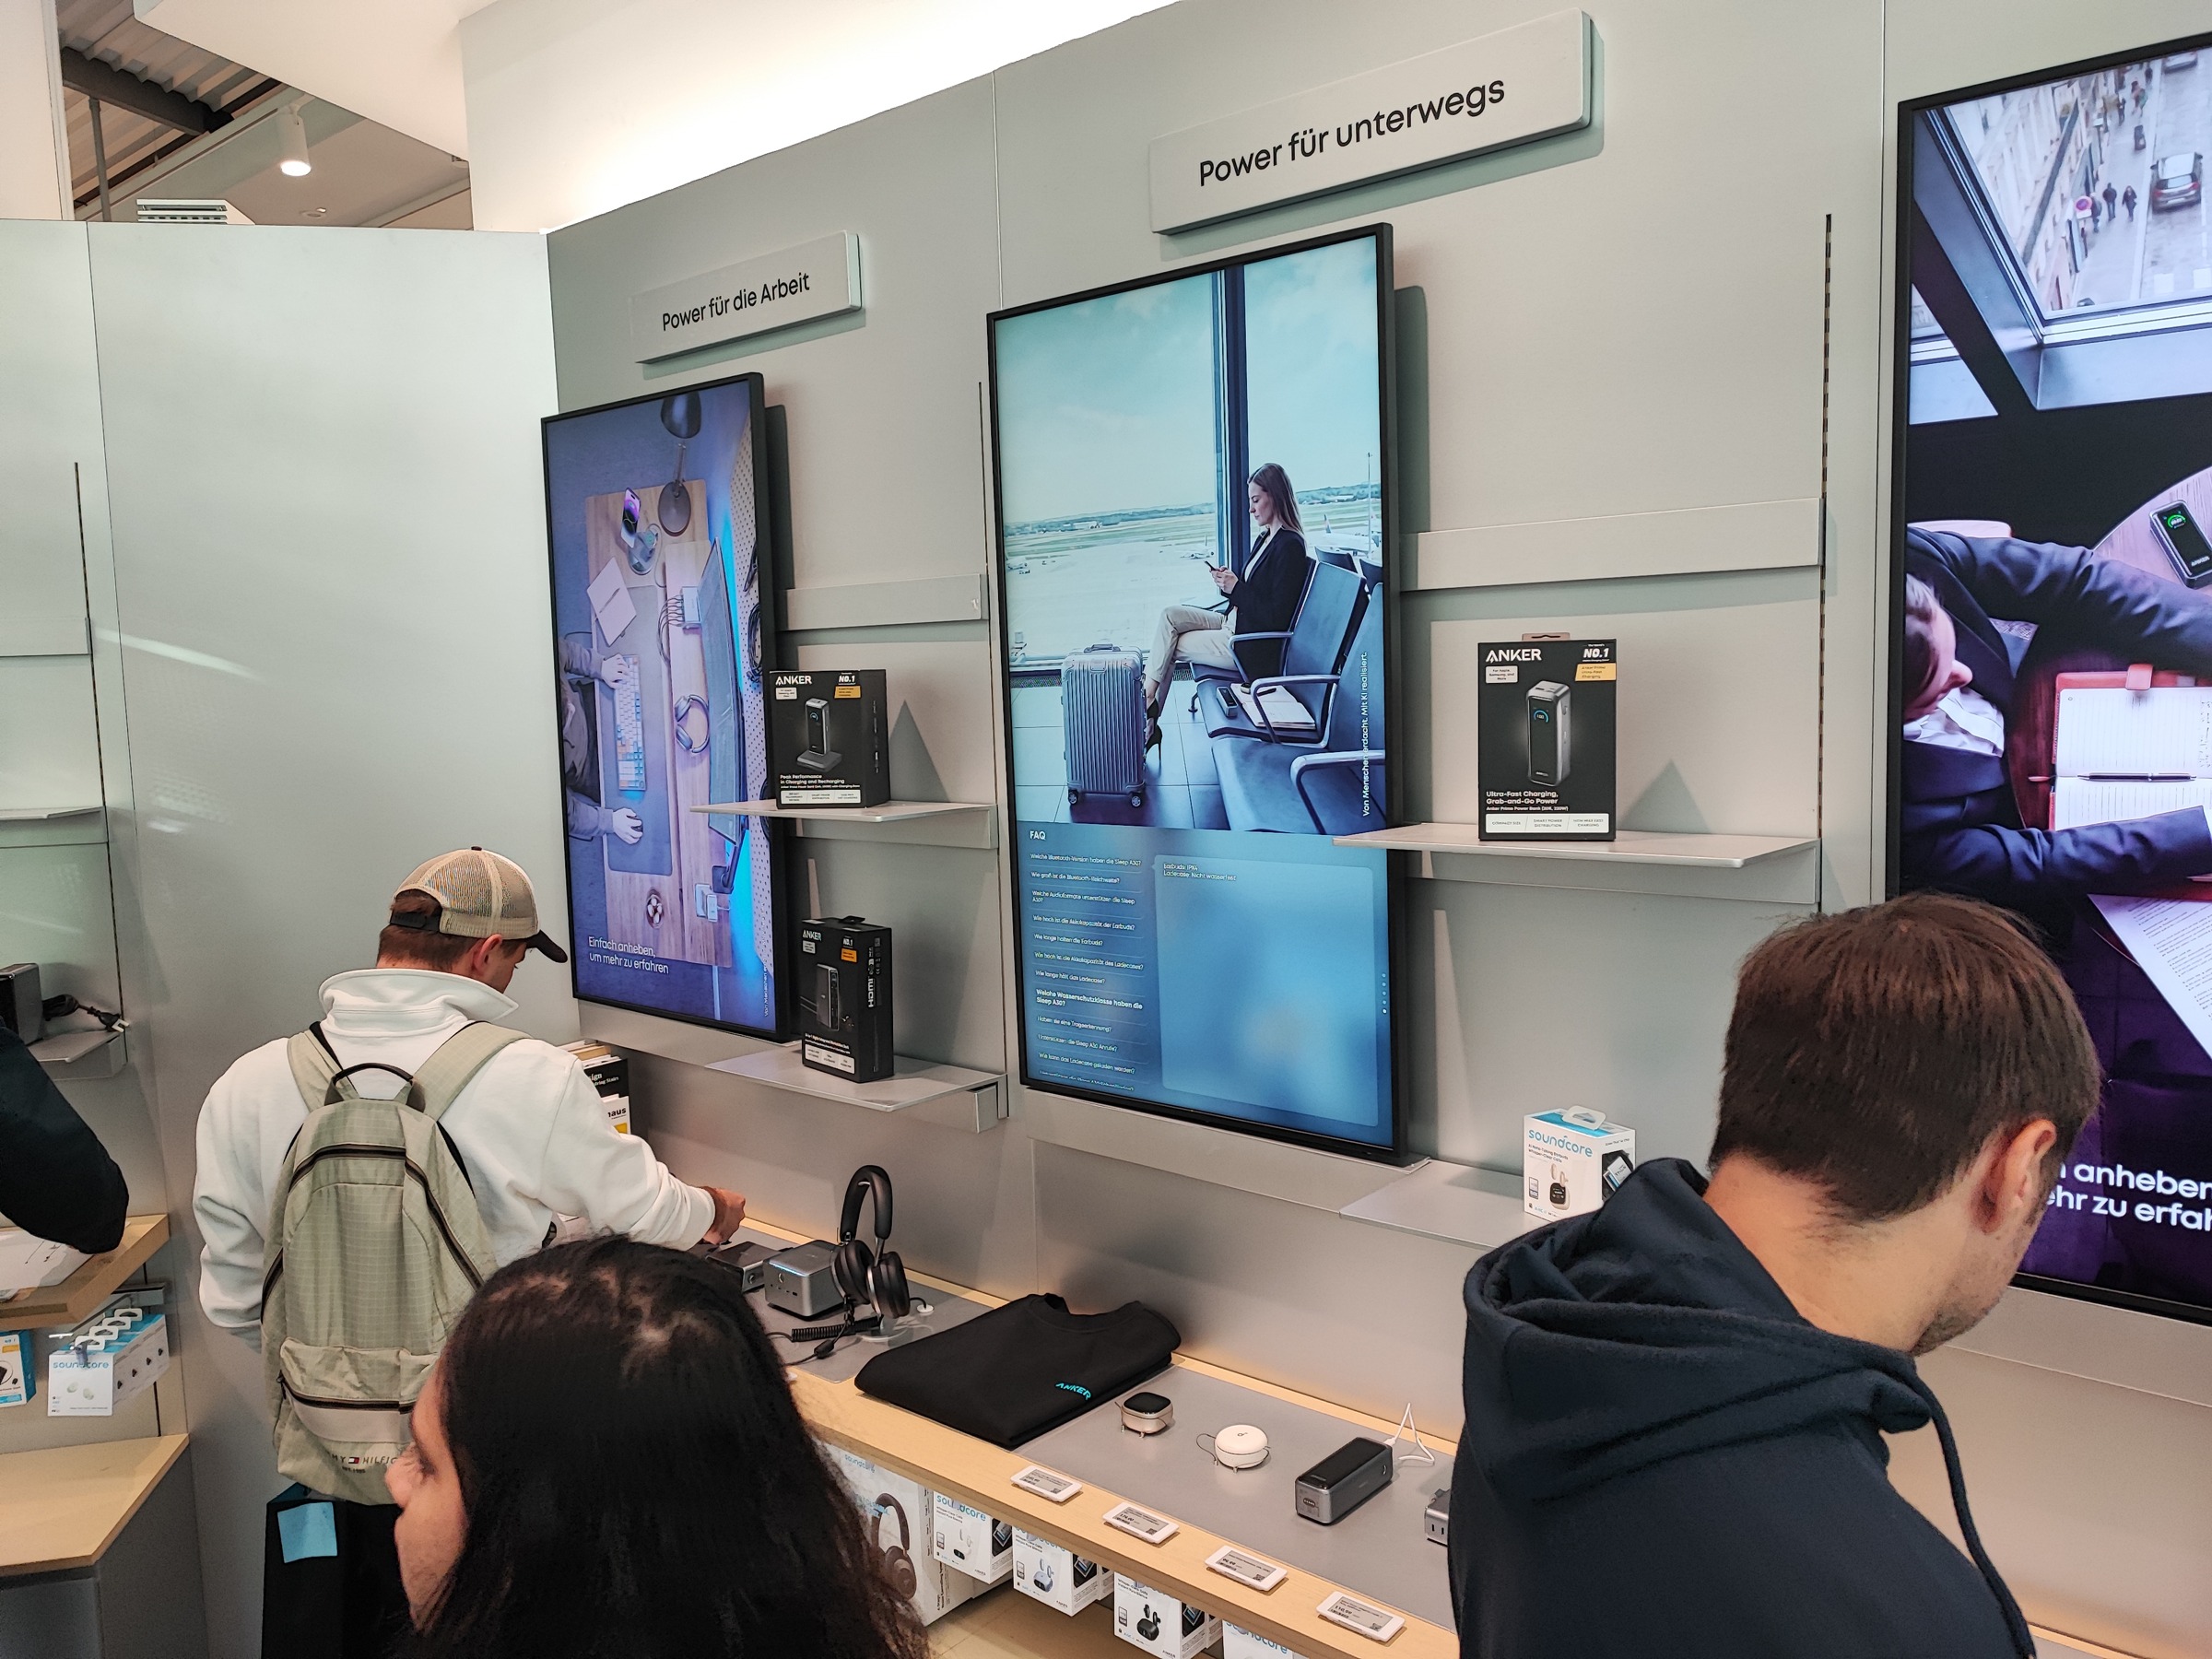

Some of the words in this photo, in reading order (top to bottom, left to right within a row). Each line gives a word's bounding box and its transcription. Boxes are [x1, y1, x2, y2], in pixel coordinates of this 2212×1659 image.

[1199, 143, 1284, 187] Power
[1287, 129, 1329, 162] für
[1335, 78, 1506, 148] unterwegs
[662, 303, 706, 332] Power
[708, 297, 730, 319] für
[732, 288, 758, 312] die
[760, 272, 810, 304] Arbeit
[1485, 648, 1542, 664] ANKER
[775, 675, 813, 686] ANKER
[1360, 652, 1369, 691] realisiert.
[1360, 700, 1370, 716] Mit
[1361, 758, 1371, 799] Menschen
[1523, 790, 1559, 798] Charging,
[1362, 800, 1371, 818] Von
[1030, 830, 1046, 841] FAQ
[802, 929, 822, 941] ANKER
[1042, 934, 1057, 942] lange
[588, 935, 618, 951] Einfach
[618, 941, 656, 959] anheben,
[589, 952, 602, 963] um
[602, 954, 622, 967] mehr
[623, 959, 633, 968] zu
[633, 958, 669, 974] erfahren
[1044, 971, 1059, 979] lange
[1036, 988, 1057, 998] Welche
[1056, 990, 1113, 1006] Wasserschutzklasse
[1112, 1000, 1133, 1009] haben
[1133, 1002, 1144, 1011] die
[1036, 996, 1052, 1006] Sleep
[1038, 1052, 1048, 1060] Wie
[1060, 1054, 1069, 1063] das
[1528, 1129, 1594, 1158] soundcore
[2046, 1184, 2088, 1211] ehr
[2092, 1194, 2127, 1218] zu
[1054, 1382, 1092, 1401] ANKER
[936, 1495, 986, 1522] soudcore
